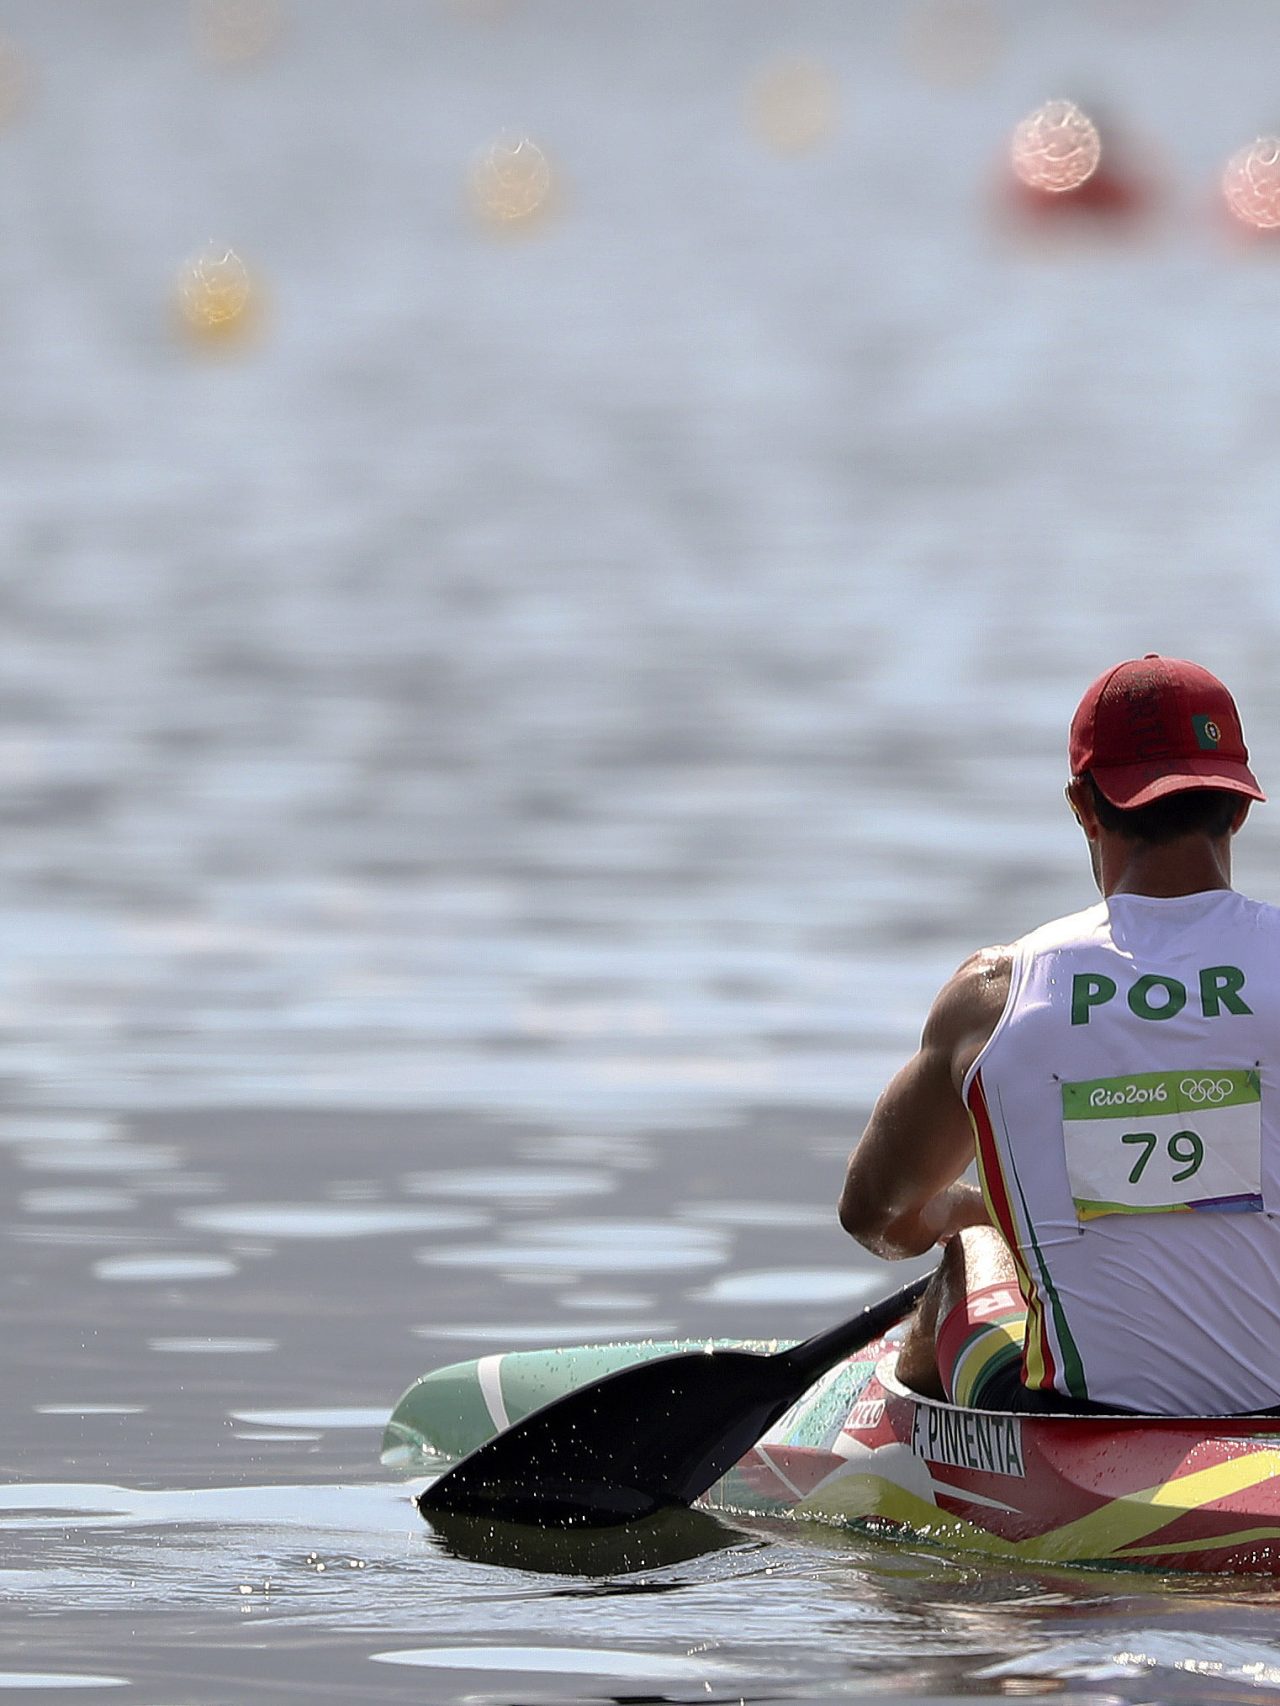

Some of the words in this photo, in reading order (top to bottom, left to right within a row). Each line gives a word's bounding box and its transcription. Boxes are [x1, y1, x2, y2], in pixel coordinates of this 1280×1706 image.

[1070, 965, 1254, 1026] POR
[1090, 1083, 1169, 1107] Rio2016
[1121, 1130, 1205, 1184] 79
[928, 1407, 1024, 1476] PIMENTA
